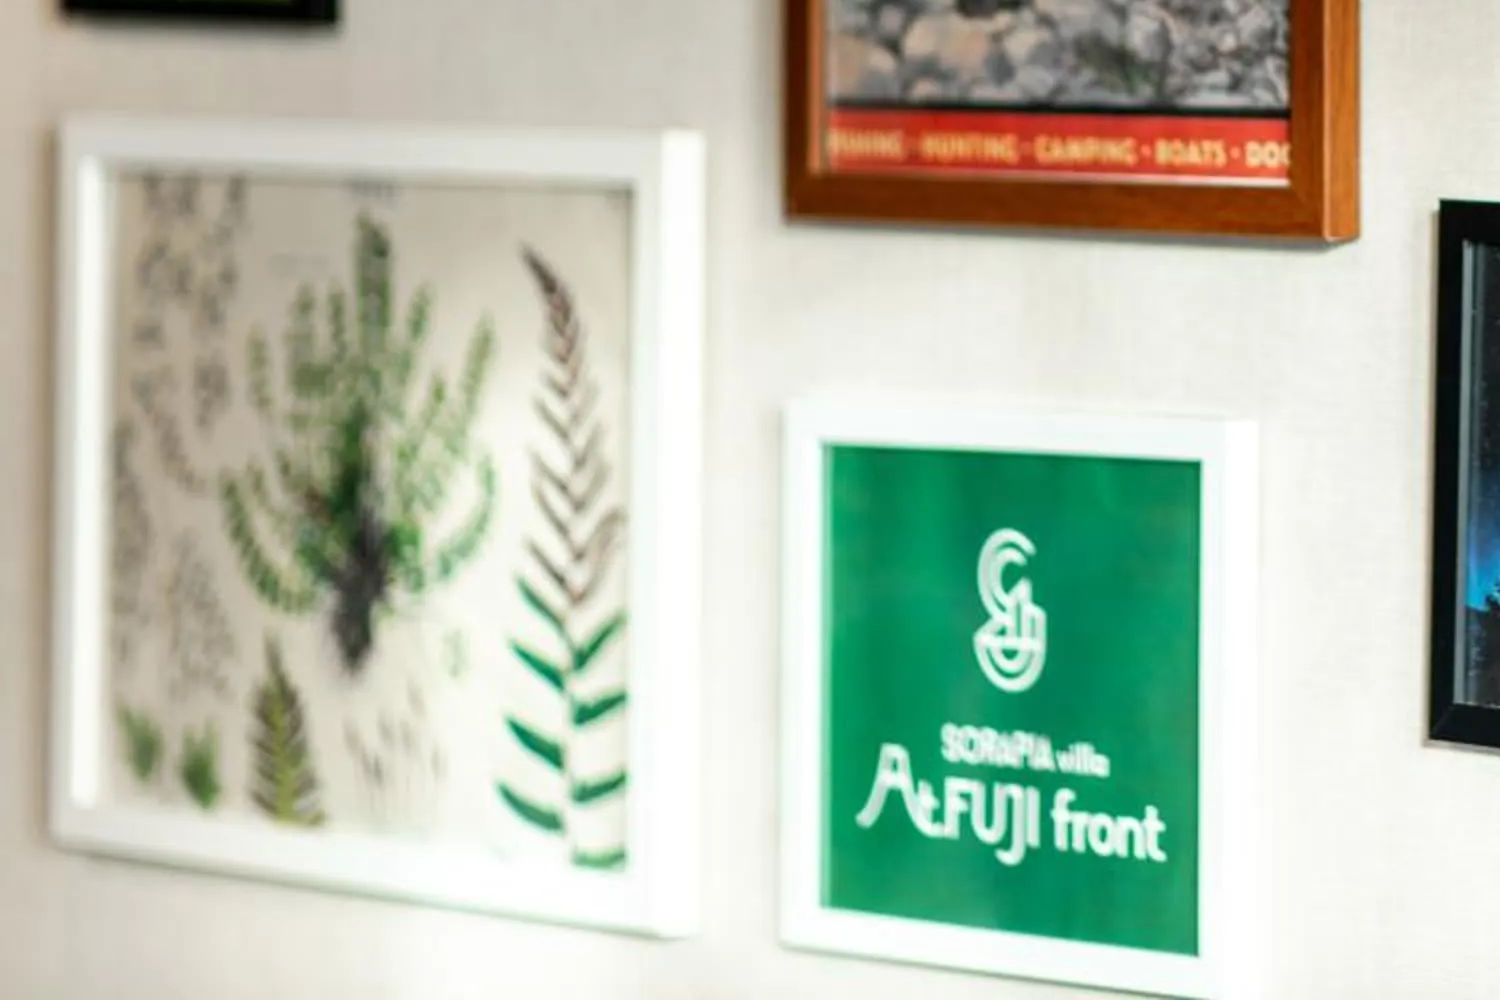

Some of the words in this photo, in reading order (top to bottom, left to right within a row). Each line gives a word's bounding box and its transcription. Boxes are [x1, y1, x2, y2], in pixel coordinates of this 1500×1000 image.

[920, 131, 1019, 165] HUNTING
[1033, 133, 1139, 167] CAMPING
[1155, 137, 1227, 168] BOATS
[941, 722, 1056, 772] SORAPIA
[1055, 741, 1110, 778] villa
[1051, 787, 1167, 862] front
